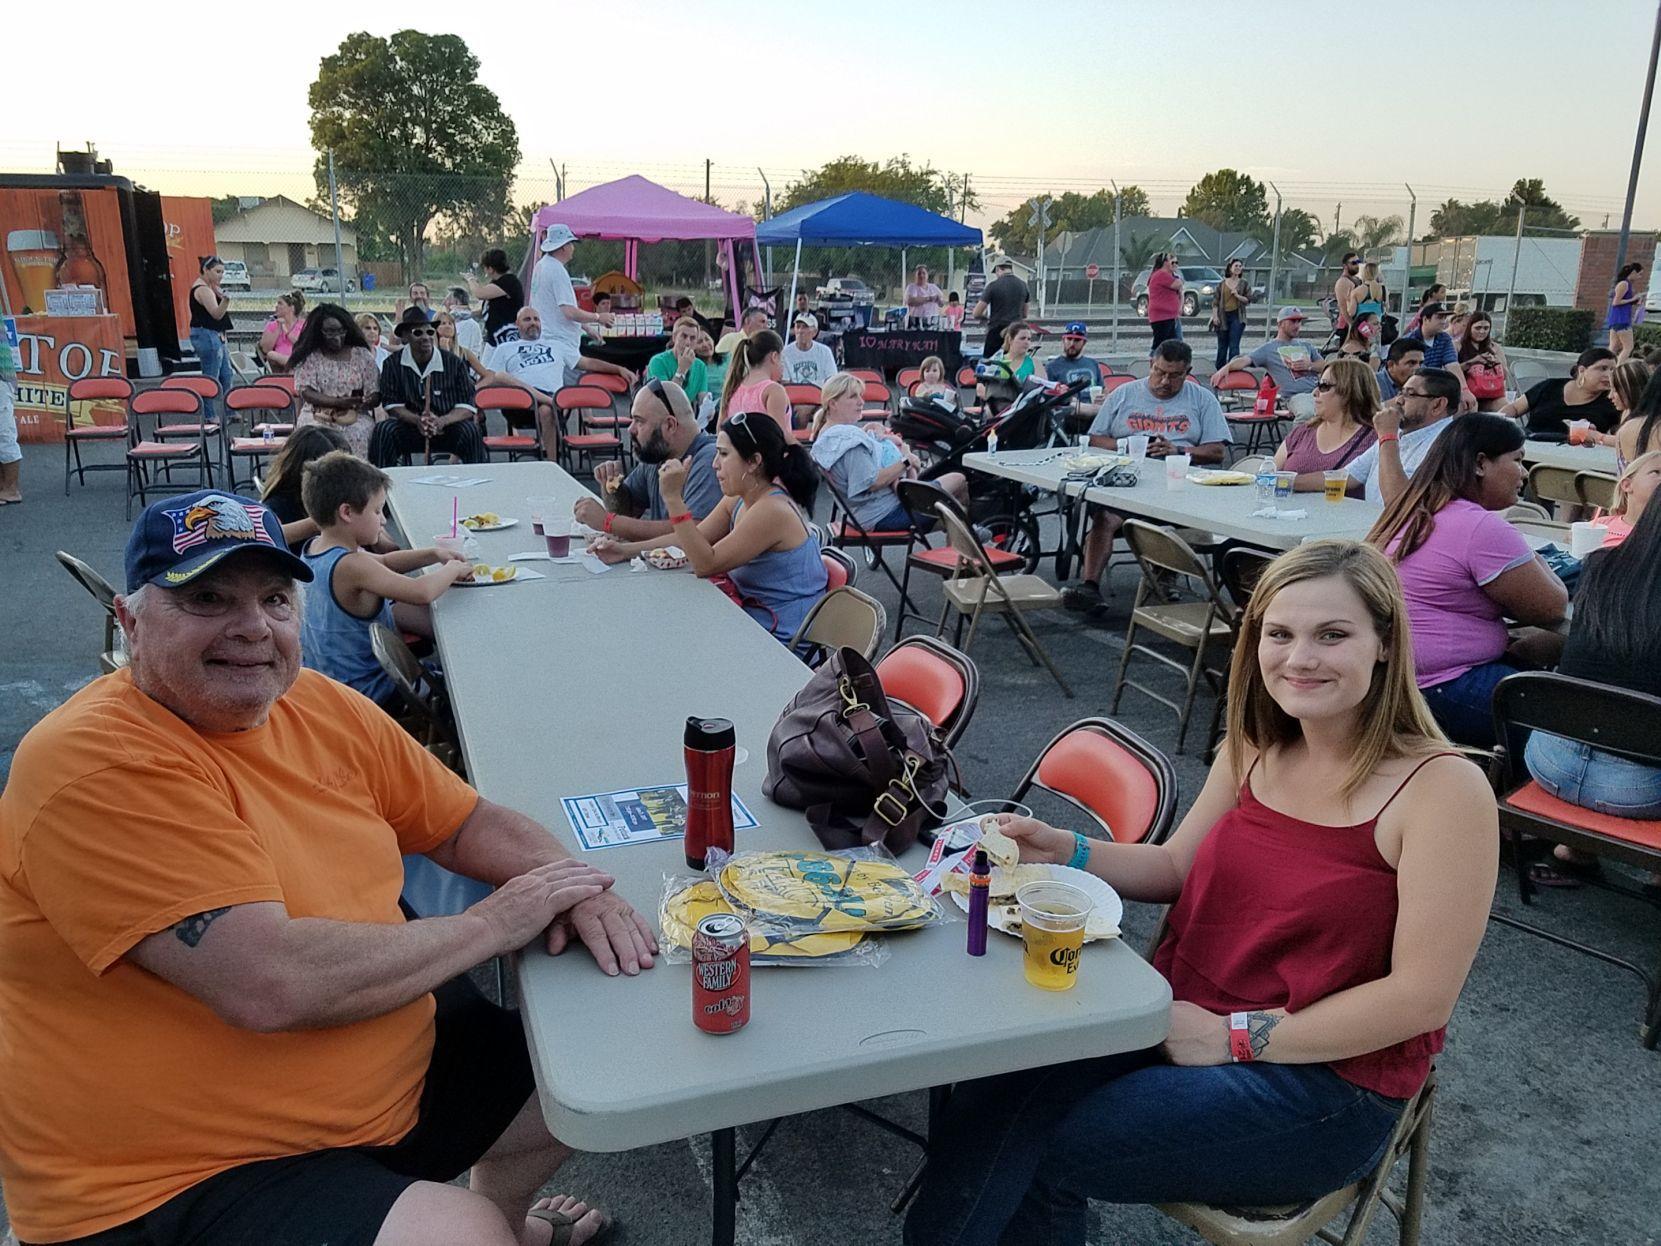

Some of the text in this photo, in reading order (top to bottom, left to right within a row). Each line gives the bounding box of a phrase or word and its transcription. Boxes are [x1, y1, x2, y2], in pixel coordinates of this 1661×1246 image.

[14, 386, 65, 407] HITE
[1127, 418, 1191, 434] GIANTS
[698, 959, 737, 977] WESTERN
[703, 974, 732, 989] FAMILY
